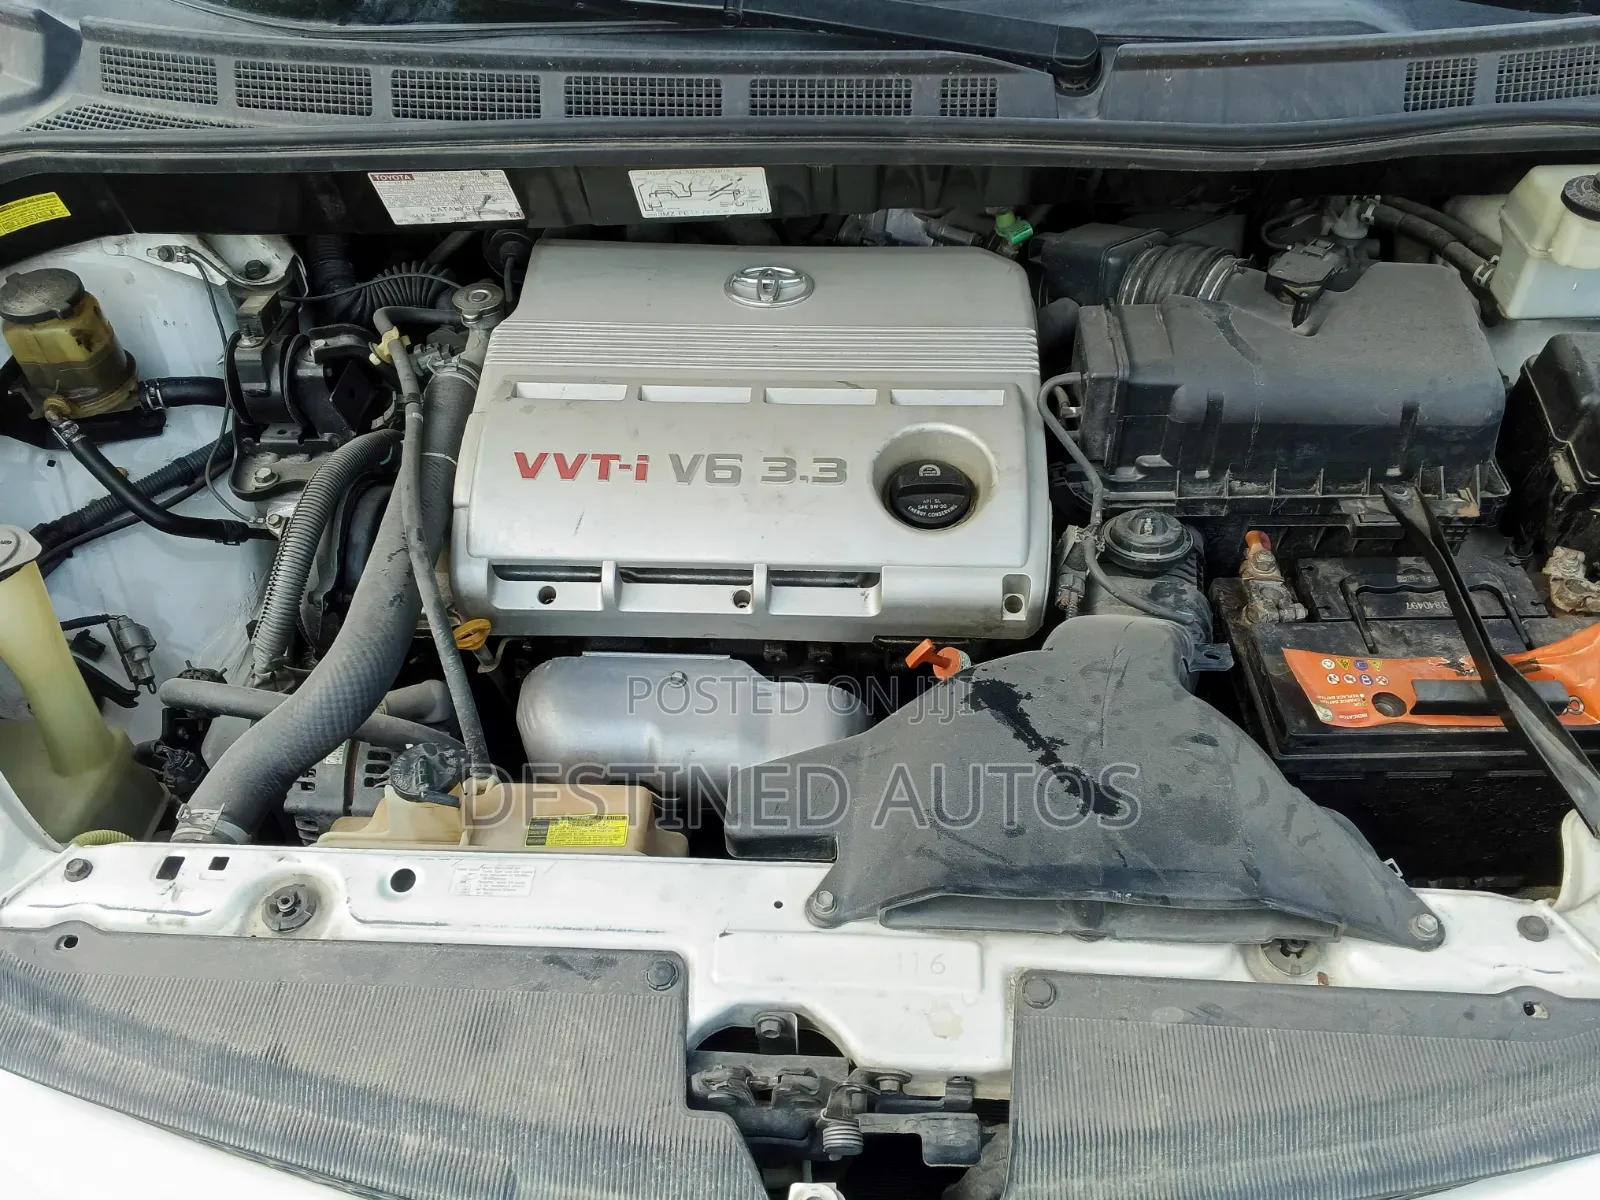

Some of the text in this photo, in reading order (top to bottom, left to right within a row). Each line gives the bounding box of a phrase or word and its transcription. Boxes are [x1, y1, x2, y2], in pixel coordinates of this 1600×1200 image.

[514, 451, 848, 488] VVT-i V6 3.3
[907, 504, 958, 518] ENERGY CONSERVING
